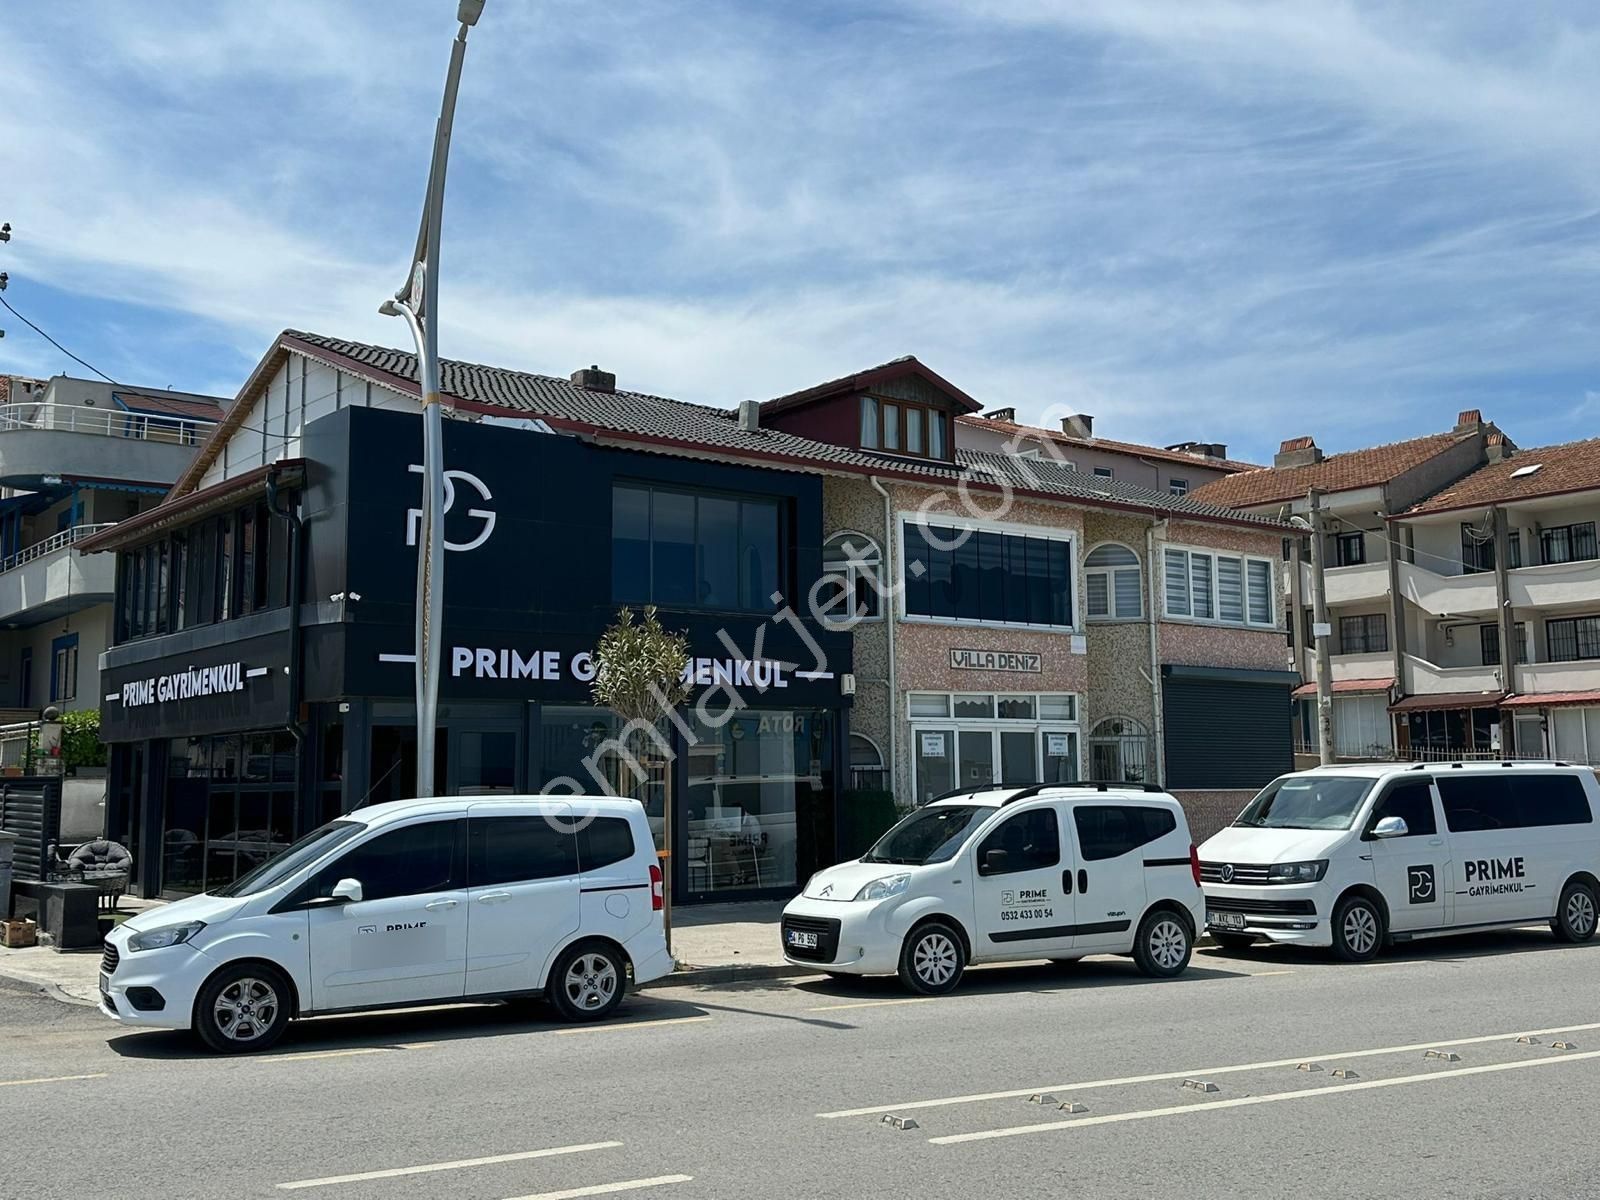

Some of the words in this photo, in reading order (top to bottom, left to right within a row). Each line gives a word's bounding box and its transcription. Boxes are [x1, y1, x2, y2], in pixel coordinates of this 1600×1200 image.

[451, 646, 561, 681] PRIME
[122, 678, 155, 708] PRIME
[157, 662, 244, 702] GAYRİMENKUL
[1464, 857, 1525, 882] PRIME
[1019, 889, 1048, 899] PRIME
[1468, 882, 1524, 897] GAYRİMENKUL
[1001, 911, 1019, 920] 0532
[1019, 909, 1033, 919] 433
[1033, 909, 1043, 919] 00
[1044, 908, 1053, 918] 54
